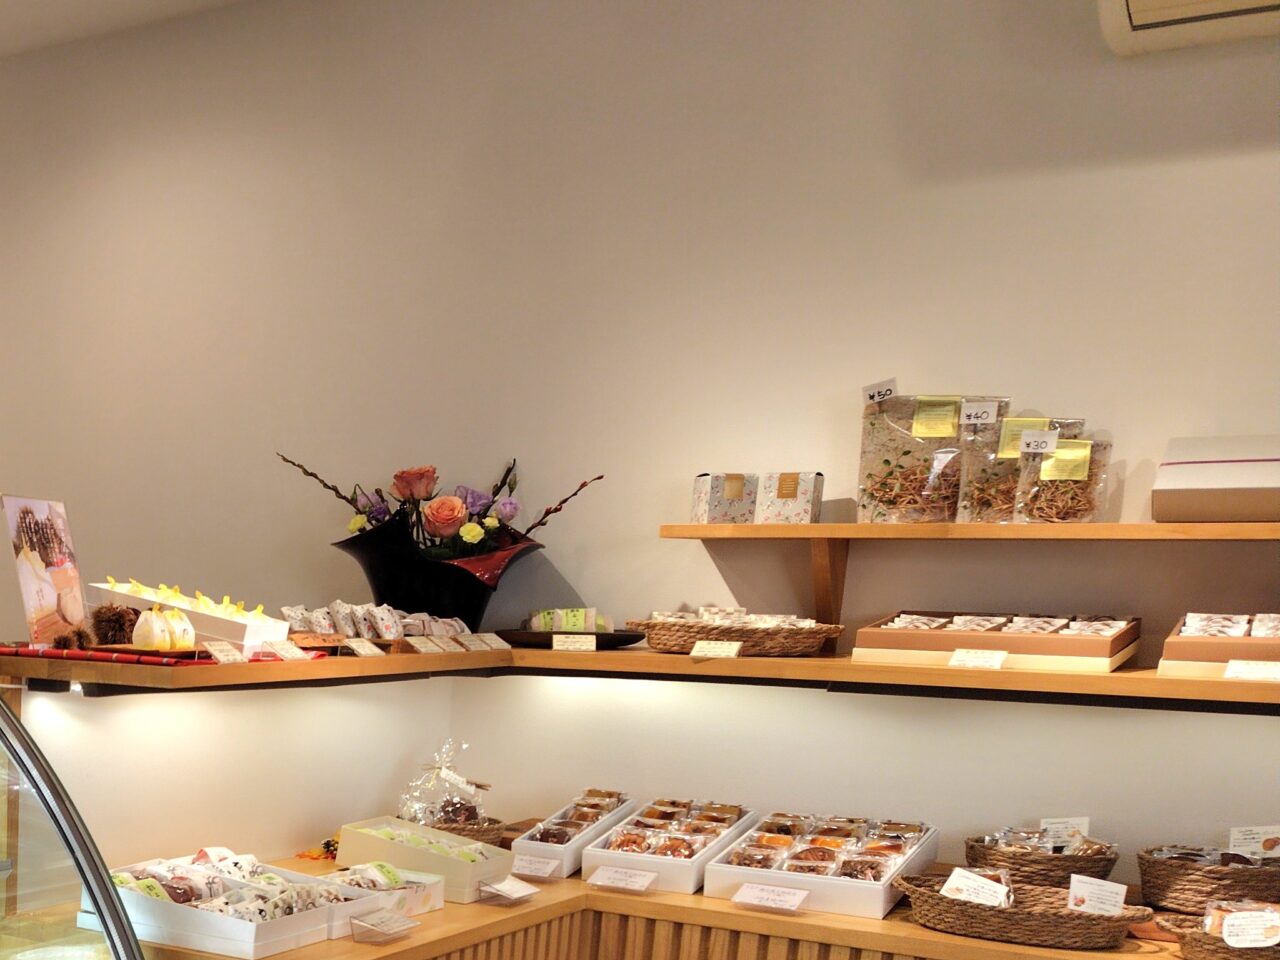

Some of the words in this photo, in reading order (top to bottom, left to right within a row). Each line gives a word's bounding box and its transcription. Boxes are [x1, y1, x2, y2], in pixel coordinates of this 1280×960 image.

[868, 387, 892, 400] ¥50
[965, 410, 990, 420] ¥40
[1024, 440, 1049, 450] ¥30
